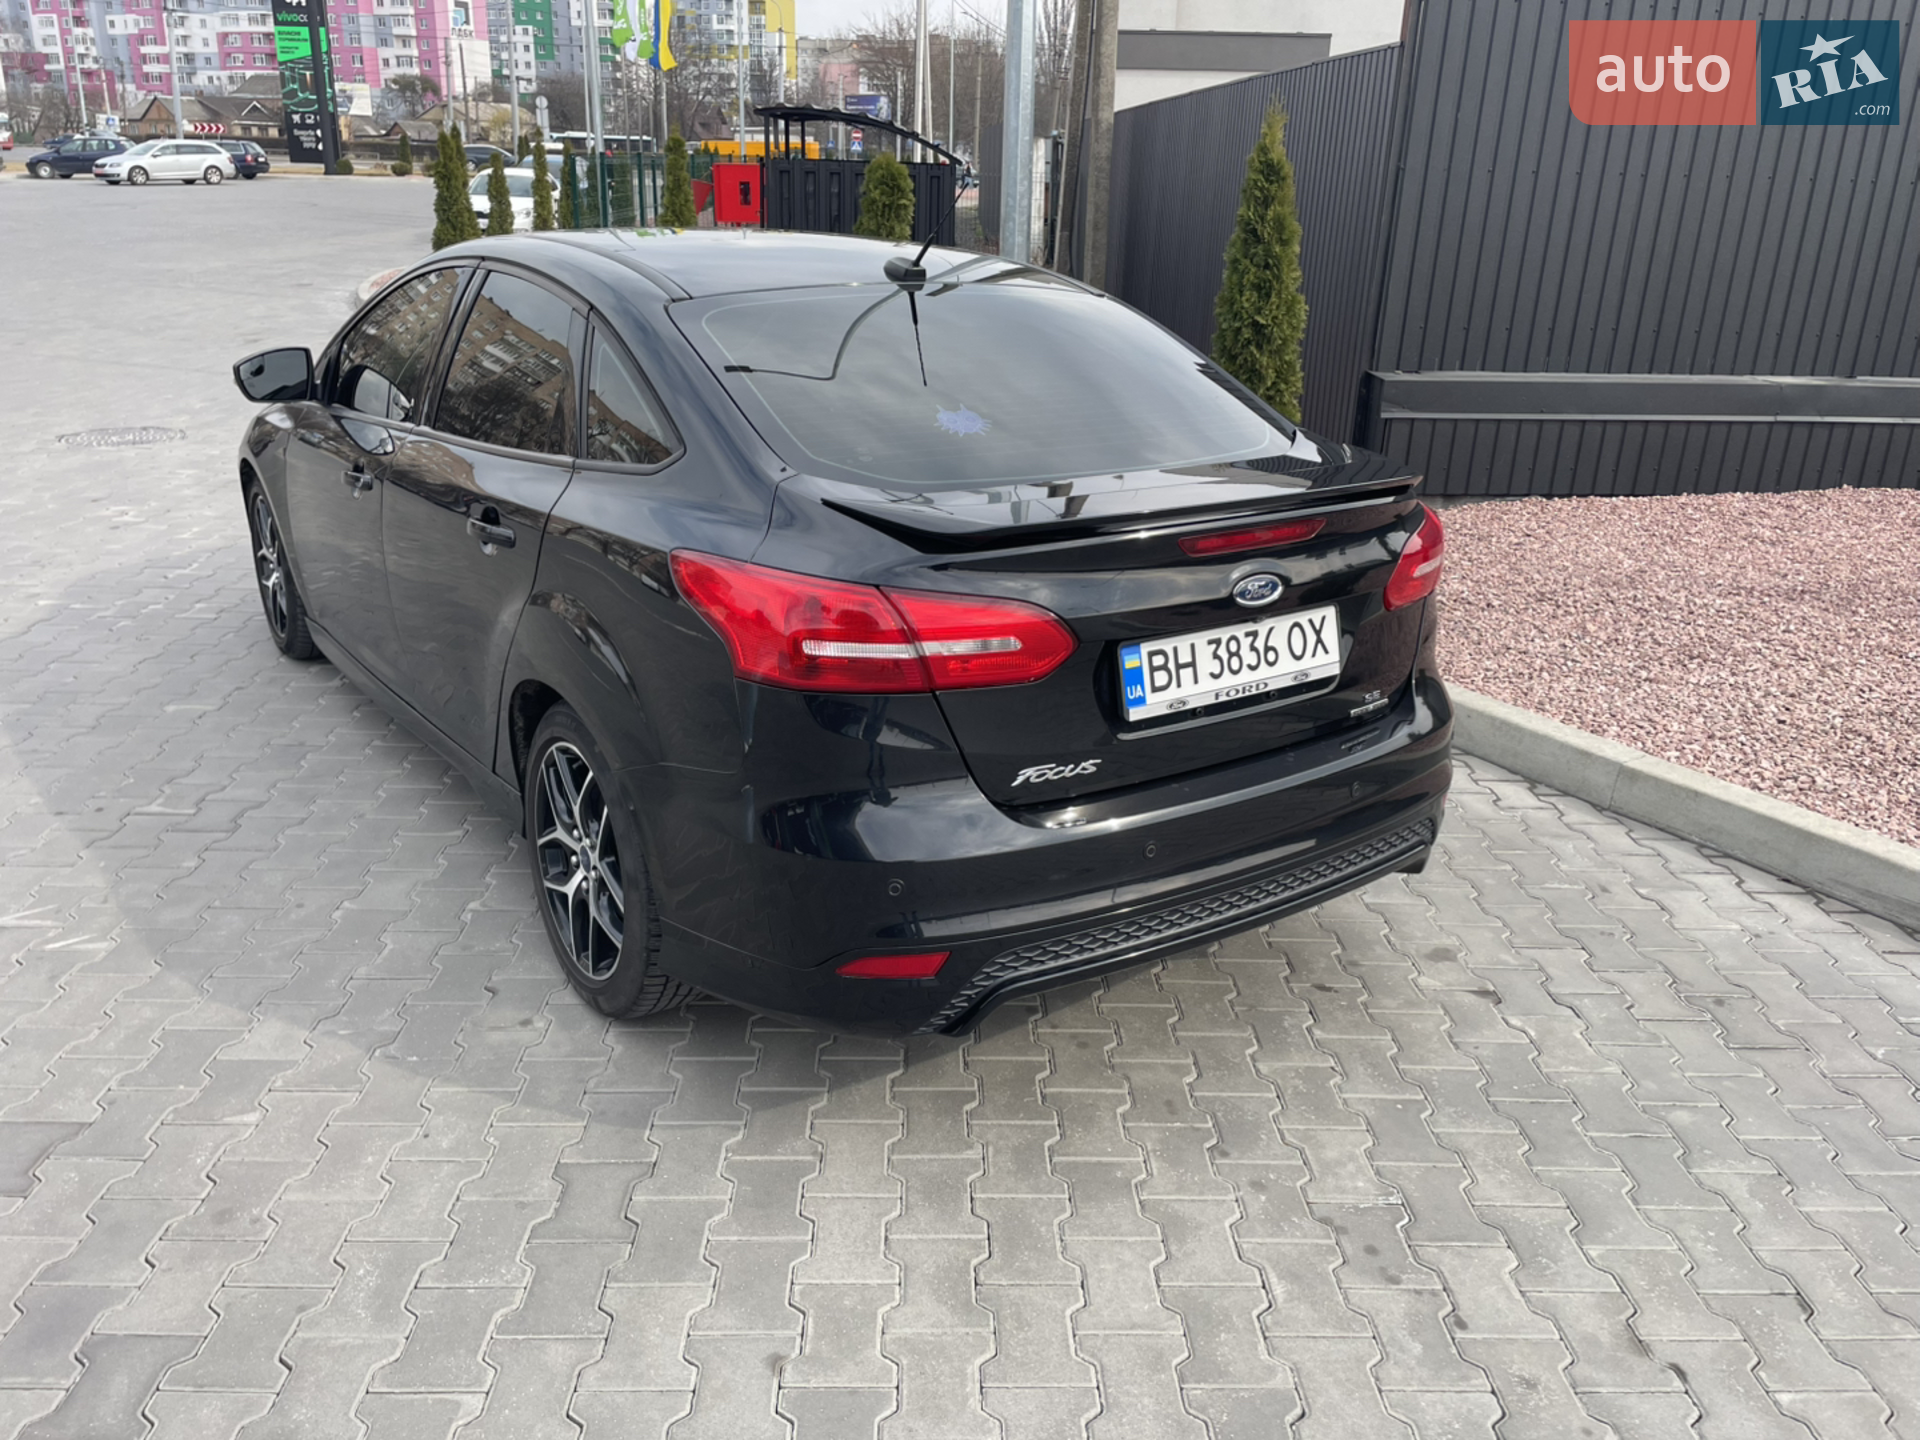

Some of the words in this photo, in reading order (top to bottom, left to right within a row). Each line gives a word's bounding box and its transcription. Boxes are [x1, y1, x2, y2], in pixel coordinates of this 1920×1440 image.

[1243, 580, 1274, 600] Ford
[1146, 642, 1199, 694] BH
[1207, 625, 1280, 680] 3836
[1287, 614, 1330, 662] OX
[1127, 683, 1145, 700] UA
[1214, 681, 1270, 701] FORD
